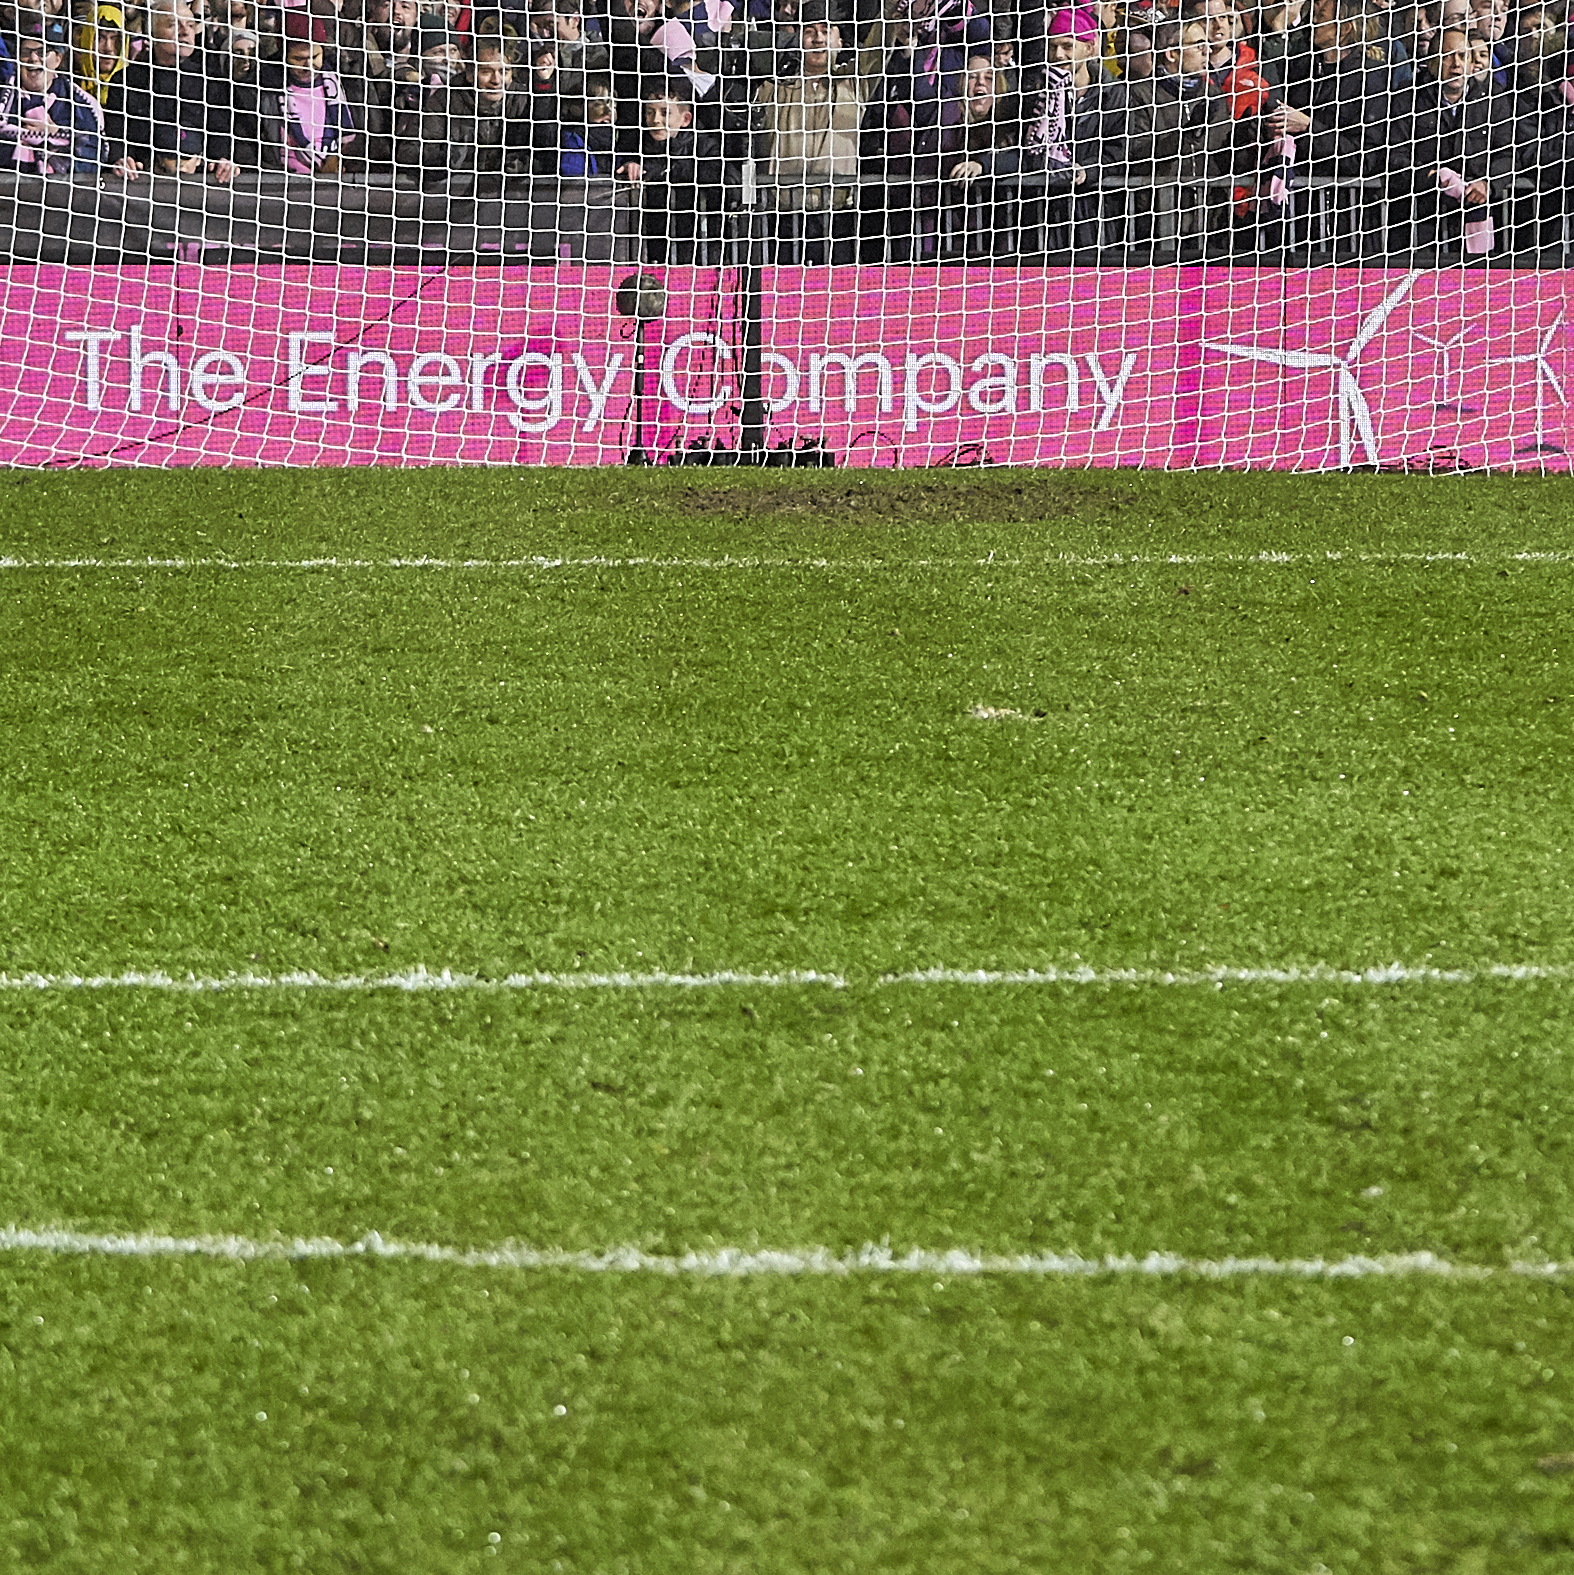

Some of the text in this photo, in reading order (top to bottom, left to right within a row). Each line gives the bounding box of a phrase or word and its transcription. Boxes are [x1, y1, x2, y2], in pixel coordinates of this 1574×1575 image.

[65, 325, 246, 414] The
[287, 330, 625, 433] Energy
[661, 332, 1138, 431] Company
